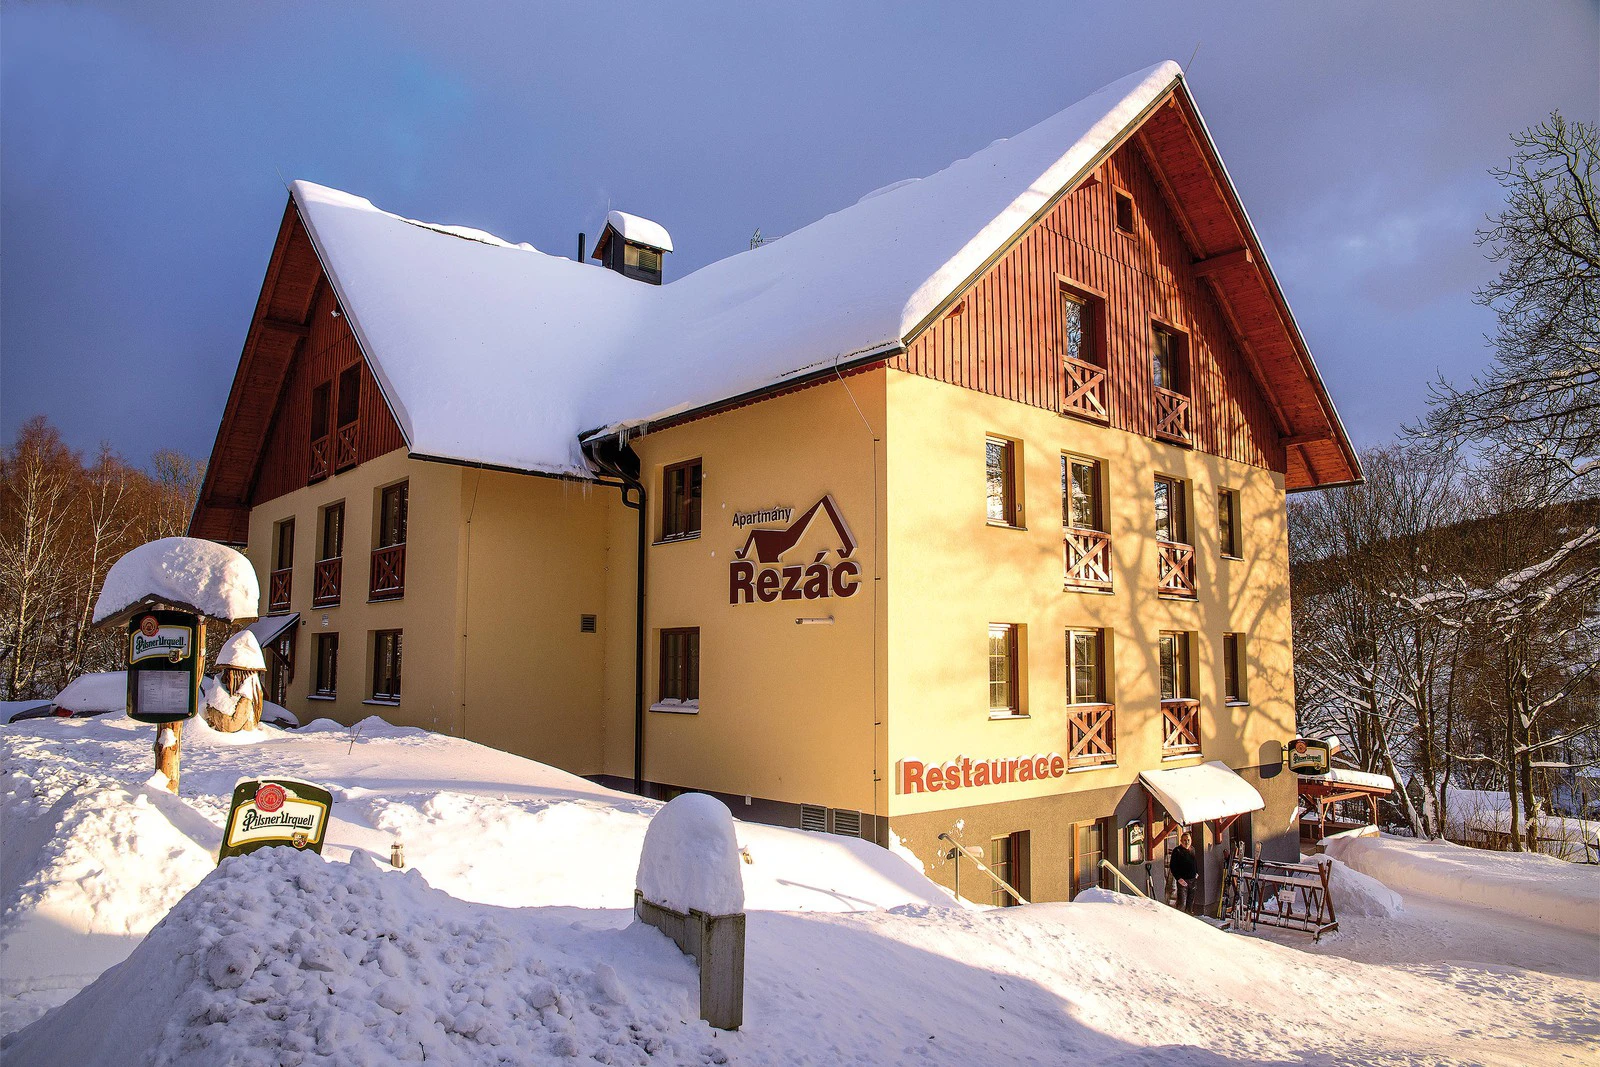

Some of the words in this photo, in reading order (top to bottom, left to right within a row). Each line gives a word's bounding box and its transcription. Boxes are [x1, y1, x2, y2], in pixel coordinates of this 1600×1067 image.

[732, 507, 792, 529] Apartmány
[729, 549, 860, 605] Řezáč
[902, 755, 1065, 795] Restaurace
[242, 808, 280, 832] Pilsner
[280, 811, 314, 829] Urquell
